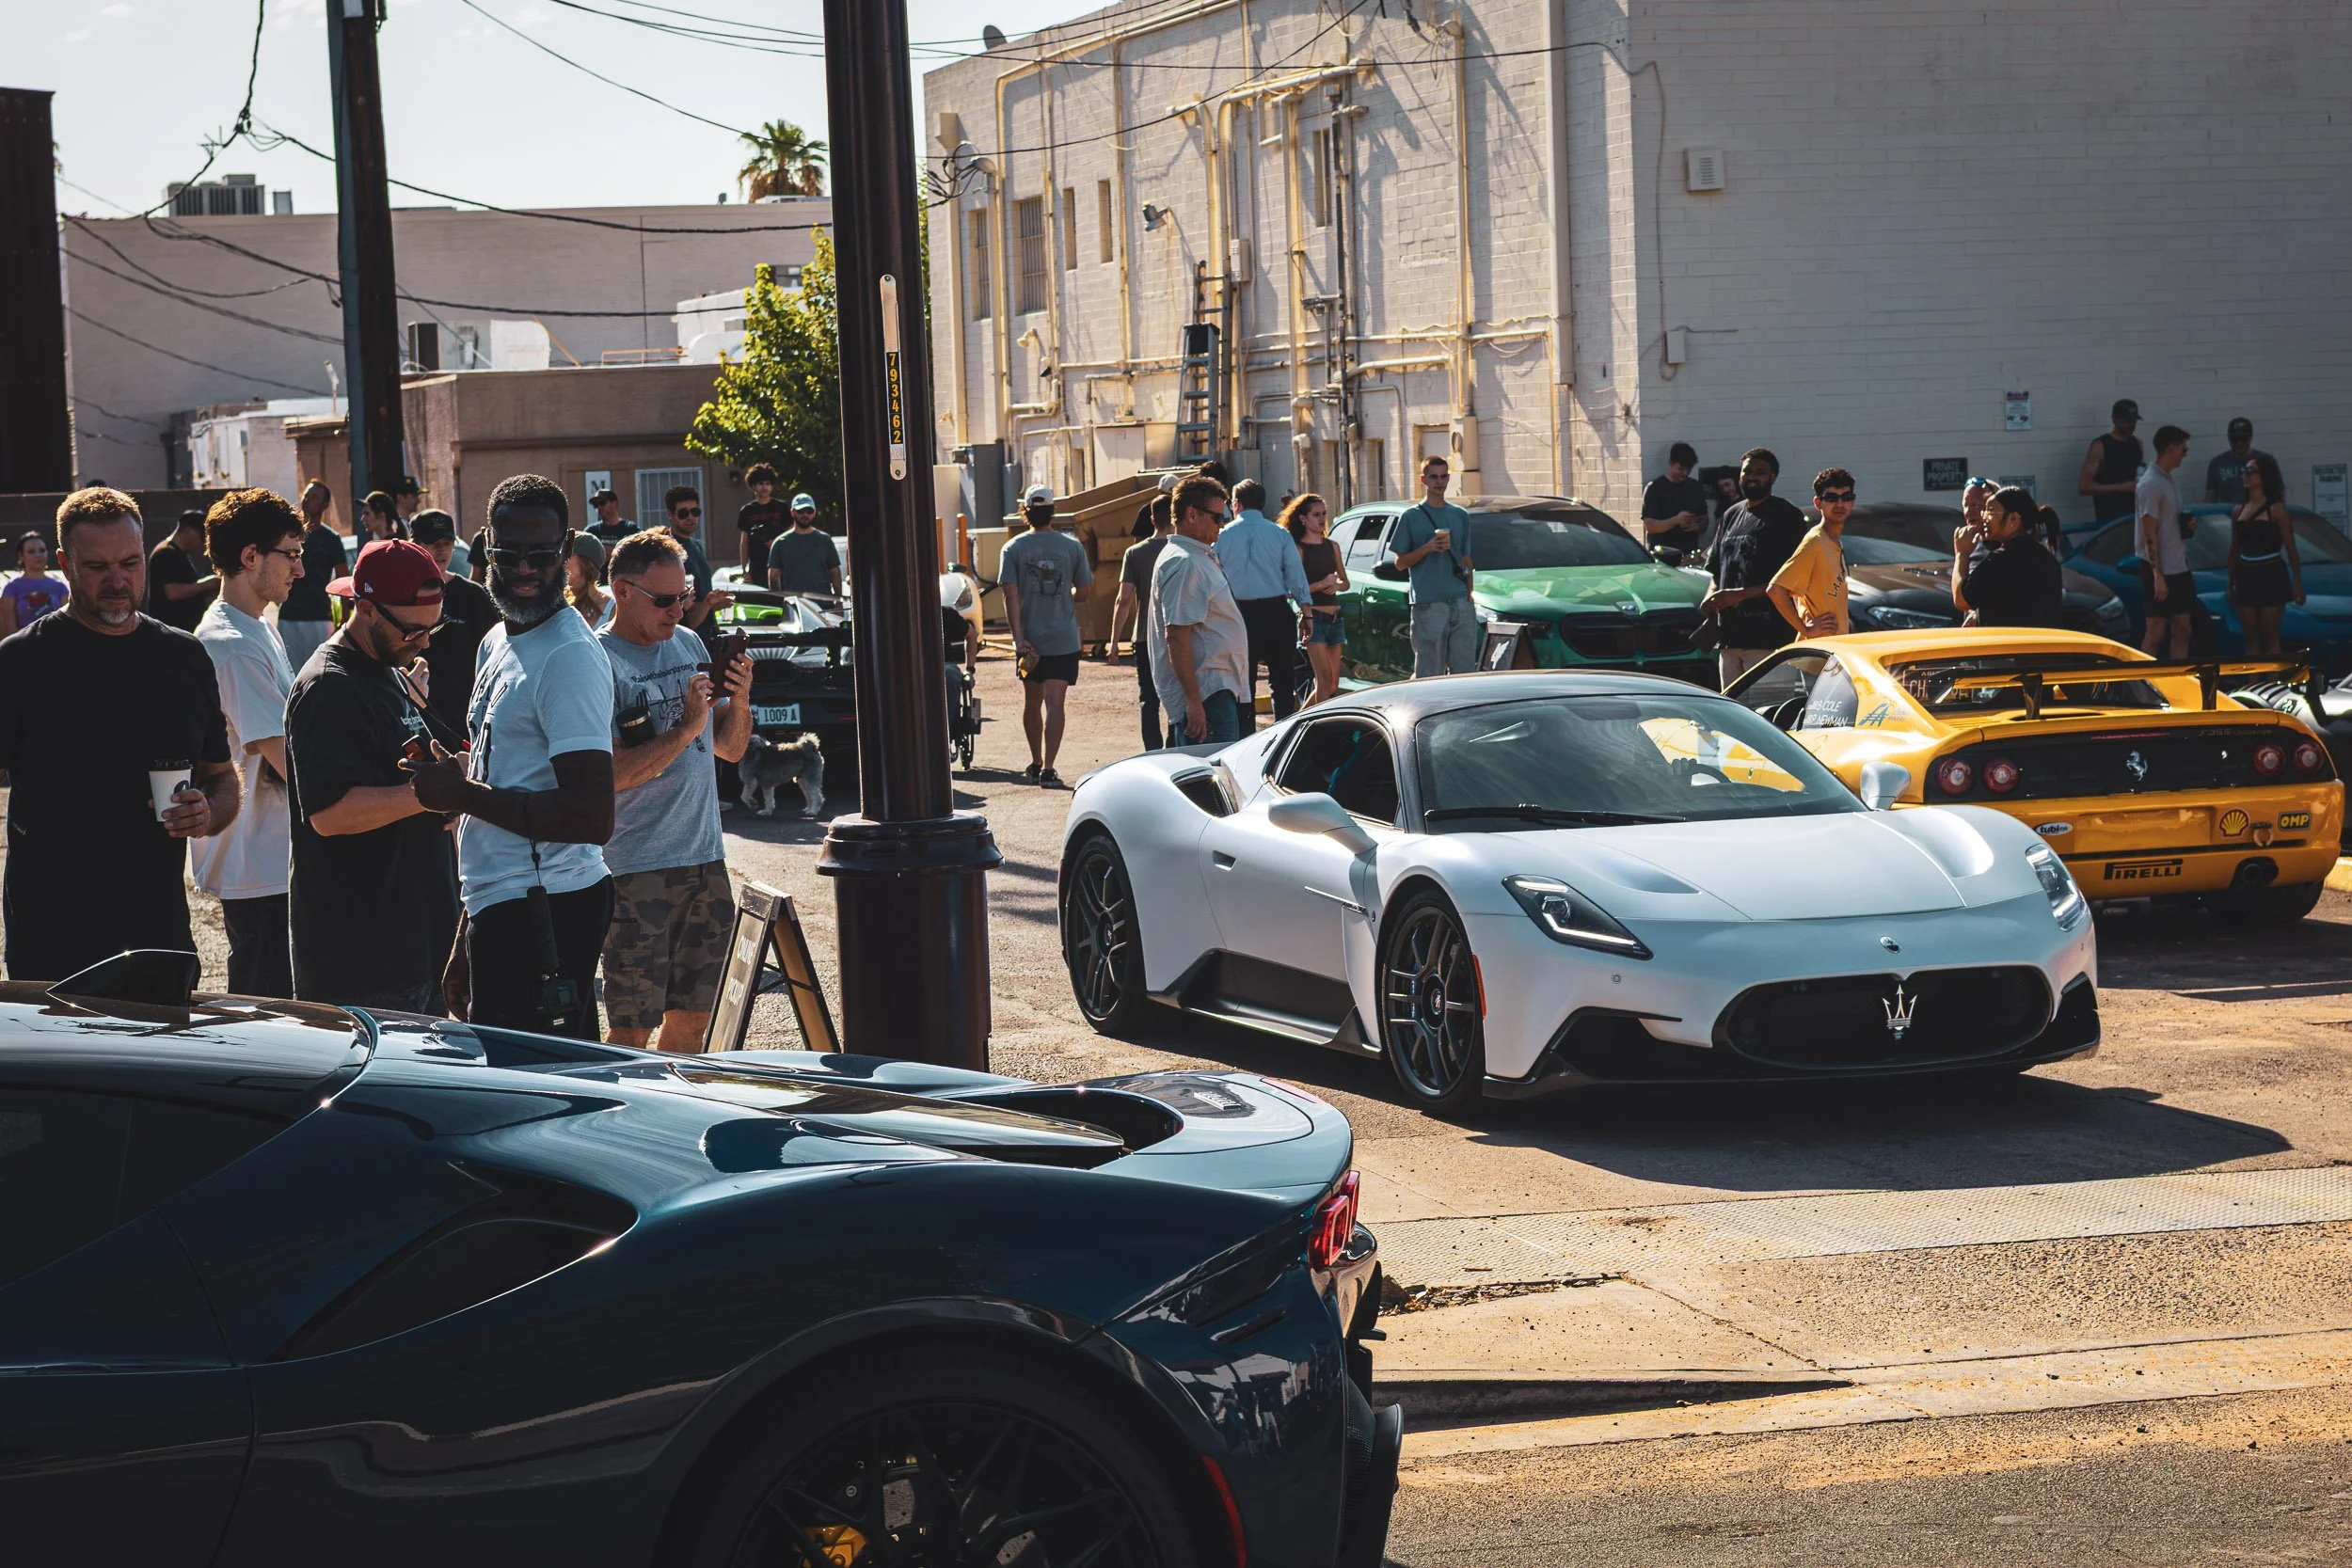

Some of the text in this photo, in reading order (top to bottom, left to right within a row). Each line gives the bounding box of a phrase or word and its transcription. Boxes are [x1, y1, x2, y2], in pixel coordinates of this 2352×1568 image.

[888, 353, 901, 443] 793462
[764, 708, 787, 722] 1009
[2280, 815, 2309, 827] OMP
[2104, 859, 2184, 880] PIRELLI
